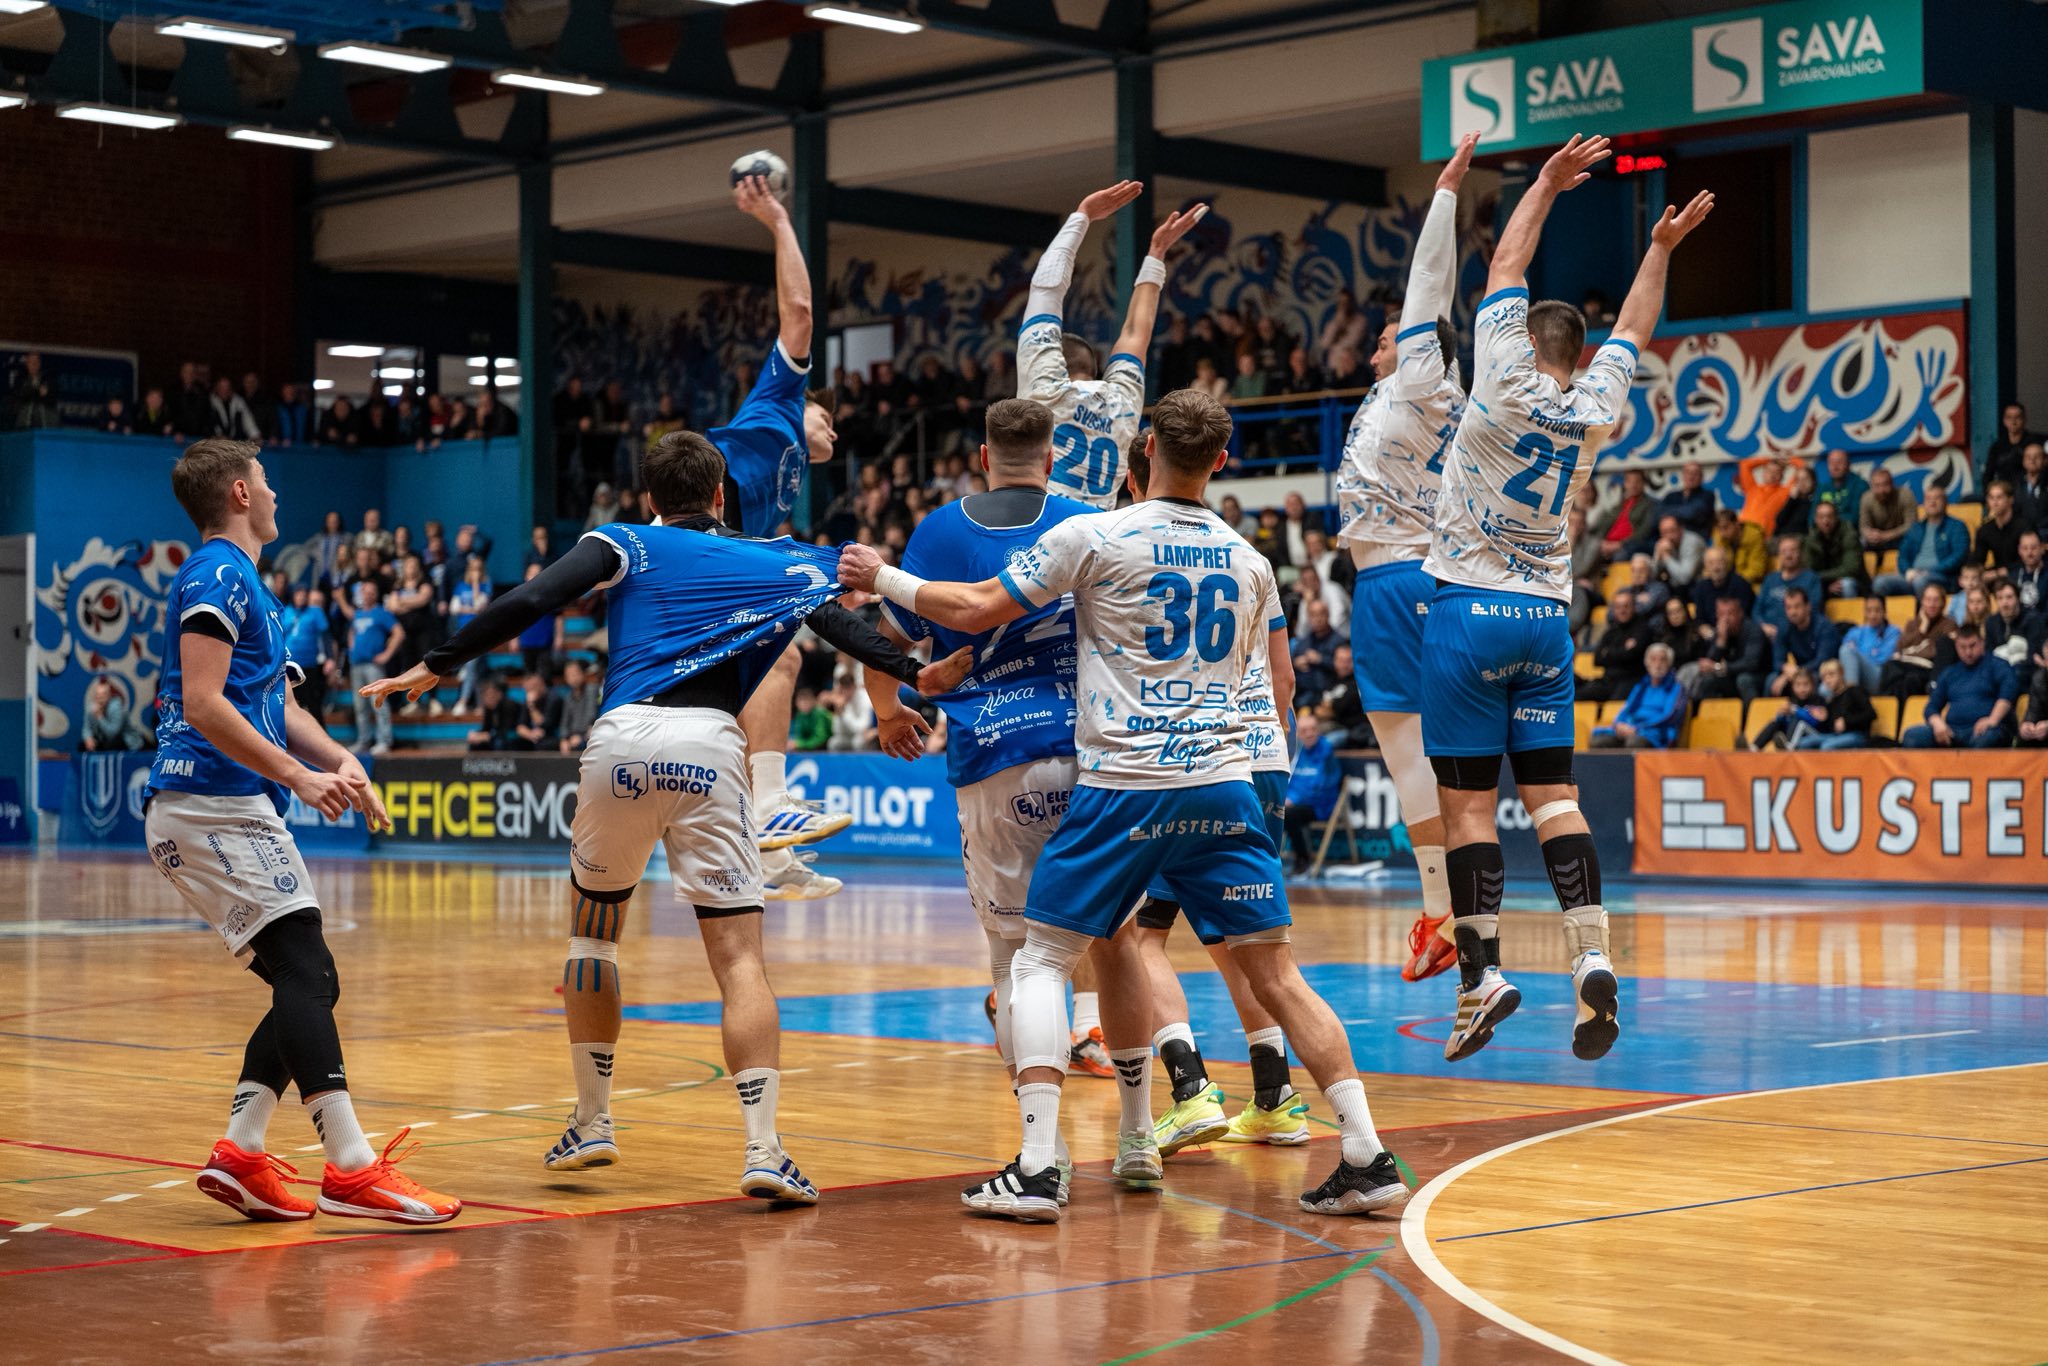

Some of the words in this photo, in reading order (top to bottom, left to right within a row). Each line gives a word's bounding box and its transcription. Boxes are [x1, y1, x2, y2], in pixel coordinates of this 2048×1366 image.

[1777, 14, 1885, 68] SAVA
[1526, 56, 1624, 106] SAVA
[1778, 57, 1886, 87] ZAVAROVALNICA
[1048, 424, 1119, 495] 20
[1502, 432, 1580, 516] 21
[1153, 544, 1232, 569] LAMPRET
[1145, 571, 1239, 663] 36
[1490, 604, 1553, 620] KUSTER
[983, 656, 1035, 683] ENERGO-S
[973, 687, 1036, 725] Aboca
[1024, 709, 1053, 722] trade
[1513, 707, 1557, 724] ACTIVE
[651, 762, 717, 782] ELEKTRO
[656, 778, 712, 797] KOKOT
[824, 785, 934, 828] PILOT
[1751, 776, 2048, 858] KUSTE
[1151, 819, 1225, 839] KUSTER
[206, 832, 235, 877] Radenska
[702, 874, 751, 887] TAVERNA
[1222, 883, 1274, 901] ACTIVE
[221, 904, 255, 938] TAVERNA
